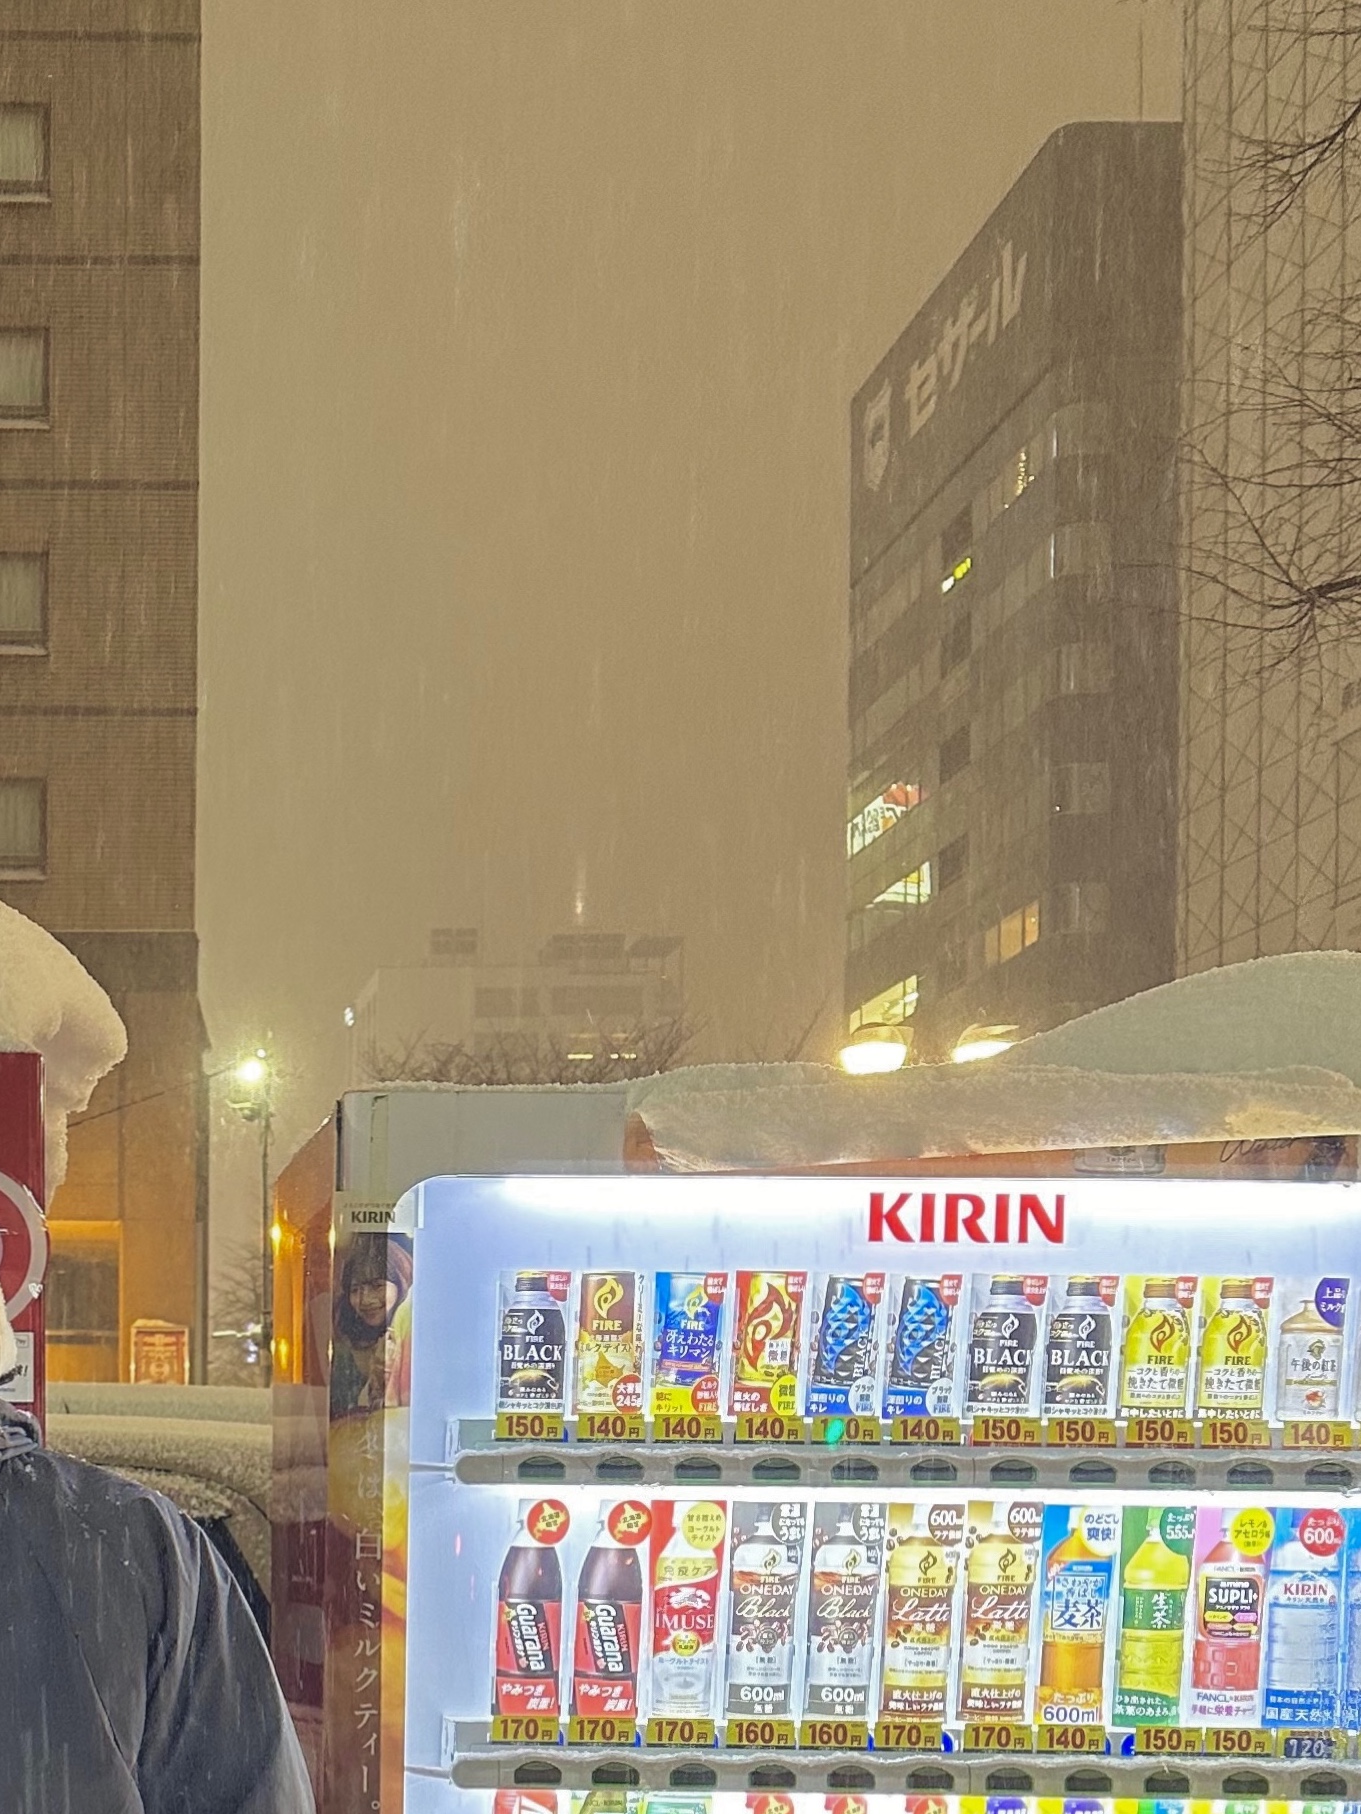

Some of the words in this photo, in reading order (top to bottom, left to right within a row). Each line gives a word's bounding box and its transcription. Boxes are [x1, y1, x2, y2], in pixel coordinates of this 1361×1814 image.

[904, 240, 1028, 440] セザール
[351, 1211, 395, 1224] KIRIN
[868, 1192, 1065, 1243] KIRIN
[592, 1320, 622, 1331] FIRE
[503, 1345, 562, 1361] BLACK
[974, 1349, 1033, 1365] BLACK
[1051, 1350, 1109, 1366] BLACK
[1225, 1356, 1251, 1365] FIRE
[506, 1416, 558, 1437] 150円
[587, 1417, 640, 1437] 140円
[662, 1417, 715, 1438] 140円
[745, 1420, 798, 1440] 140円
[821, 1420, 873, 1440] 10円
[901, 1420, 953, 1441] 140円
[982, 1420, 1035, 1441] 150円
[1056, 1421, 1109, 1442] 150円
[1135, 1421, 1188, 1443] 150円
[1209, 1422, 1262, 1444] 150円
[1291, 1423, 1344, 1445] 140円
[740, 1584, 794, 1595] ONEDAY
[821, 1585, 873, 1595] ONEDAY
[980, 1585, 1027, 1595] ONEDAY
[1209, 1588, 1253, 1604] SUPLI
[1283, 1581, 1328, 1596] KIRIN
[1054, 1600, 1102, 1628] 麦茶
[516, 1604, 545, 1671] Guarana
[595, 1604, 624, 1673] Guarana
[354, 1528, 383, 1812] 白いミルクティー。
[740, 1686, 784, 1702] 600ml
[821, 1688, 865, 1702] 600ml
[1197, 1691, 1228, 1702] FANCL
[1043, 1707, 1100, 1722] 600ml
[500, 1719, 552, 1740] 170円
[576, 1719, 629, 1740] 170円
[655, 1720, 708, 1742] 170円
[735, 1722, 788, 1744] 160円
[809, 1723, 861, 1745] 160円
[882, 1725, 935, 1746] 170円
[972, 1726, 1025, 1748] 170円
[1046, 1727, 1099, 1749] 140円
[1143, 1730, 1196, 1751] 150円
[1212, 1730, 1265, 1751] 150円
